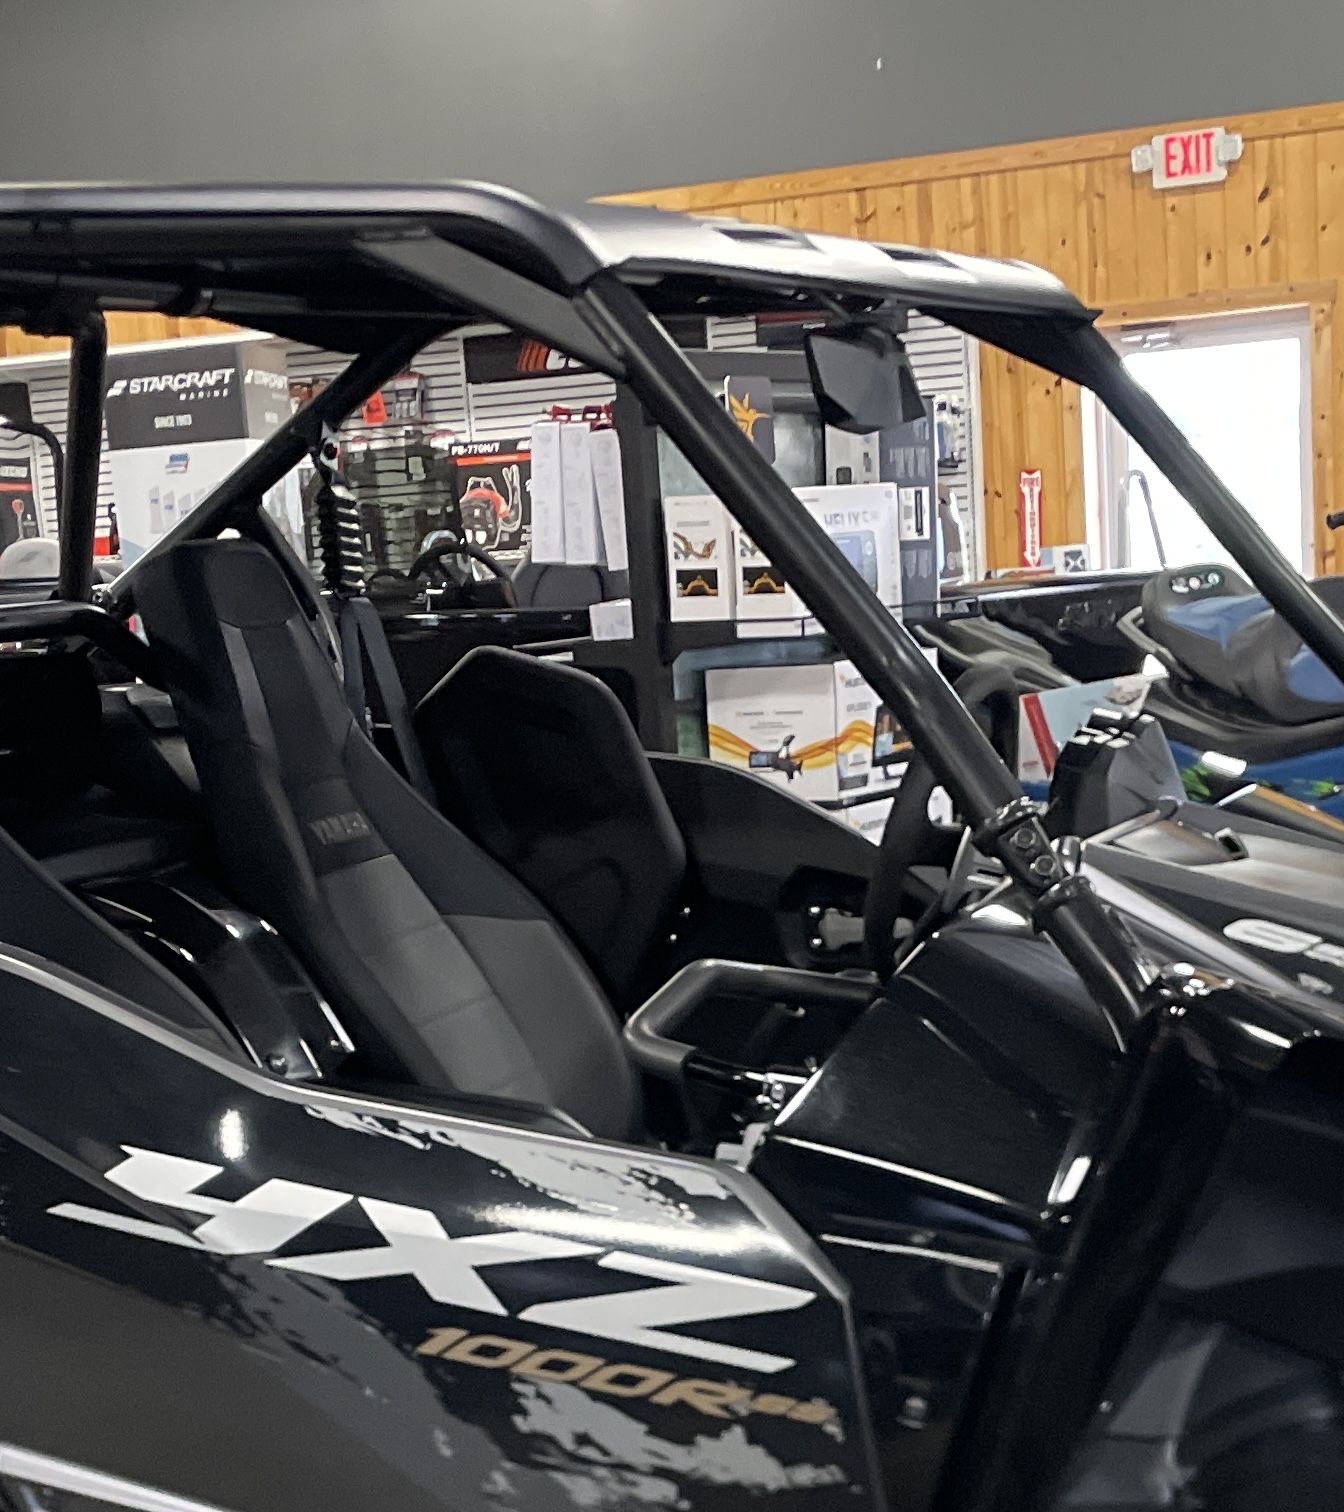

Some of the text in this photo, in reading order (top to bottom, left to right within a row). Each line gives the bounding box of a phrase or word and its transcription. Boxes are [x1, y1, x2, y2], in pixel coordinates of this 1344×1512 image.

[1164, 132, 1214, 179] EXIT
[129, 368, 235, 394] STARCRAFT
[179, 387, 229, 401] MARINE
[46, 1145, 817, 1374] YXZ
